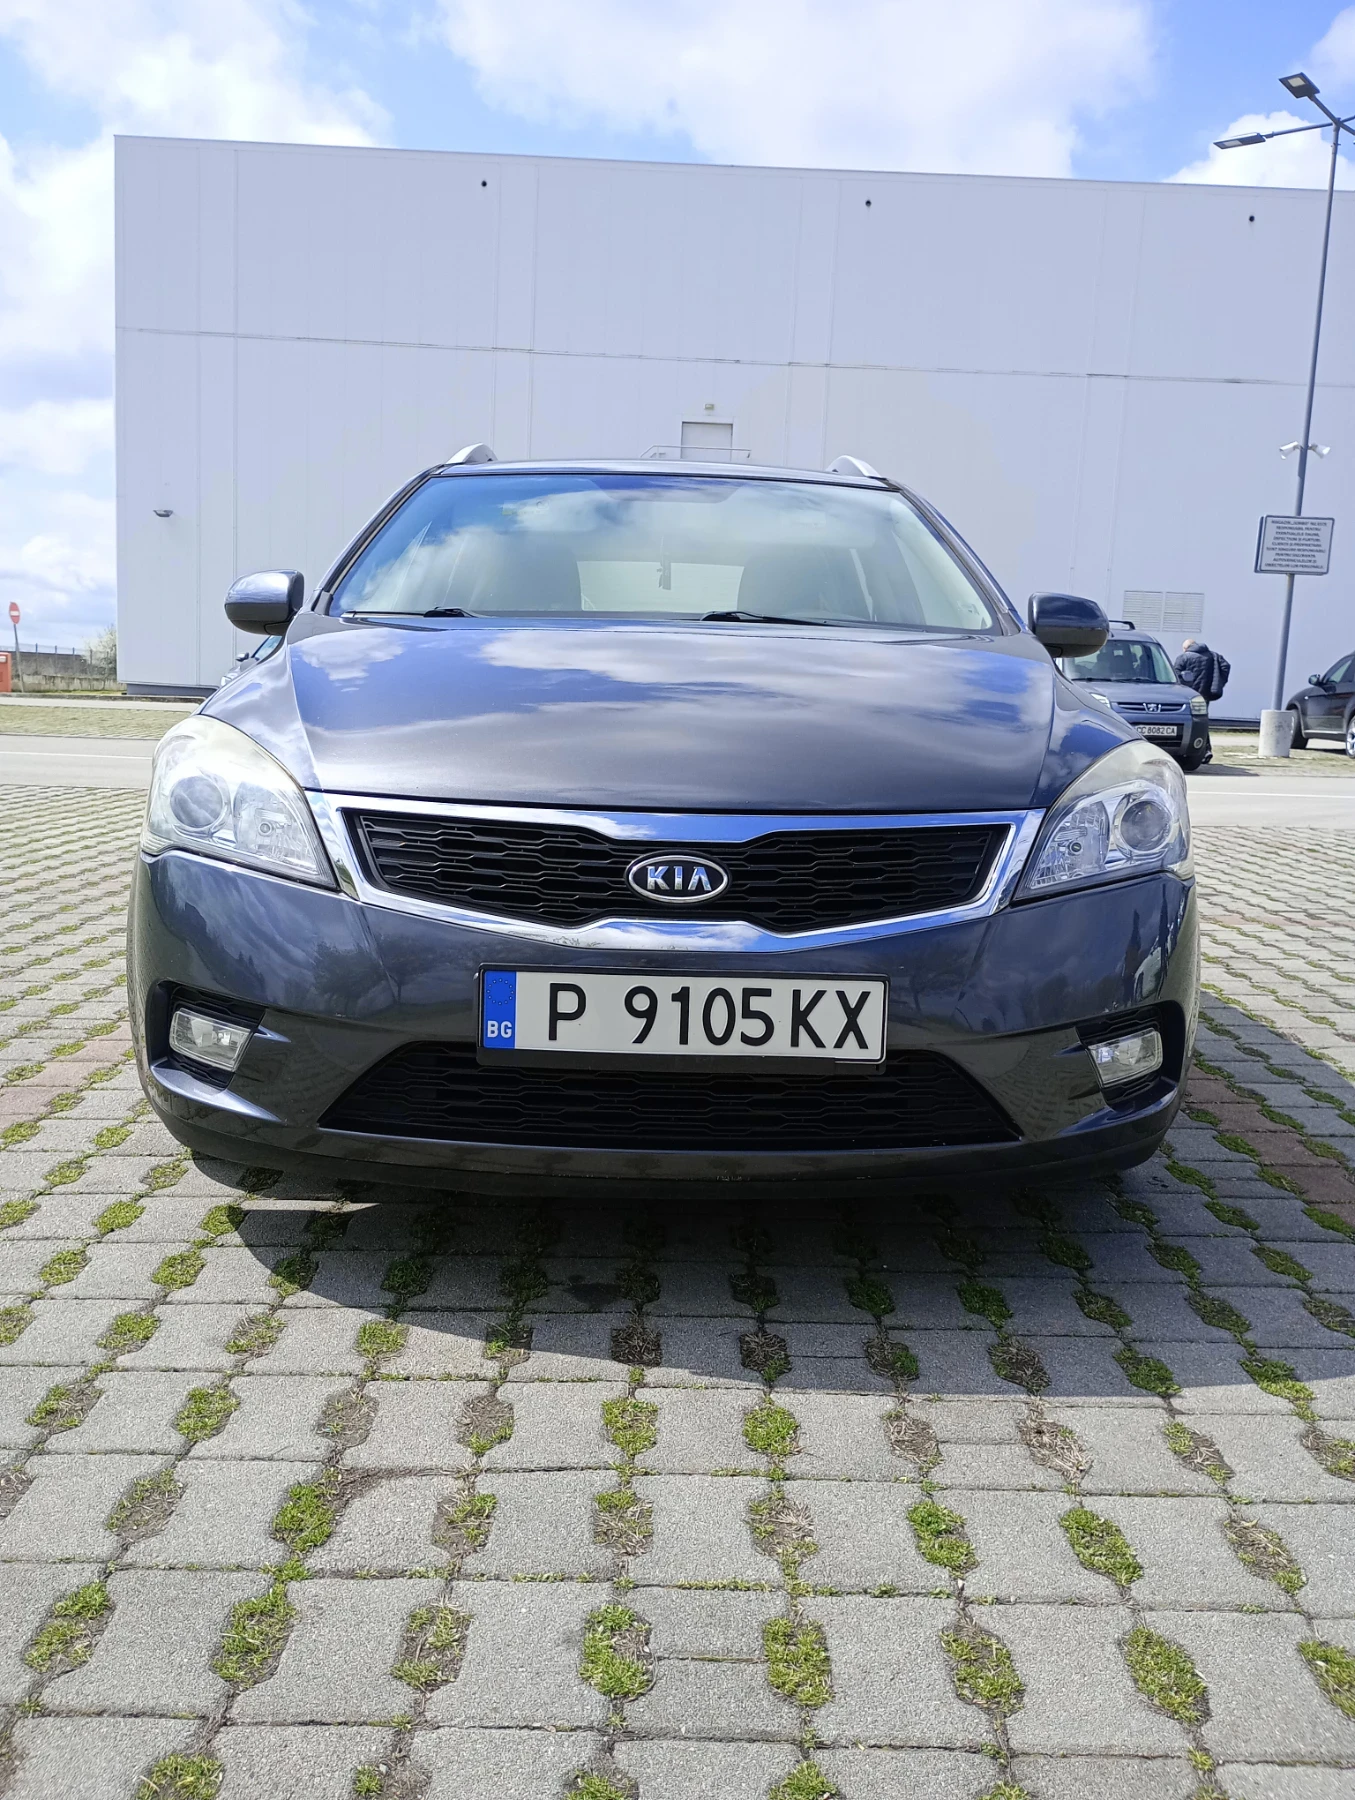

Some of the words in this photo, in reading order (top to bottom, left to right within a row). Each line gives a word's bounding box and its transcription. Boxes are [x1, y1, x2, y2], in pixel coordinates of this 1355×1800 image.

[647, 865, 712, 891] KIA
[548, 982, 587, 1042] P
[487, 1020, 513, 1039] BG
